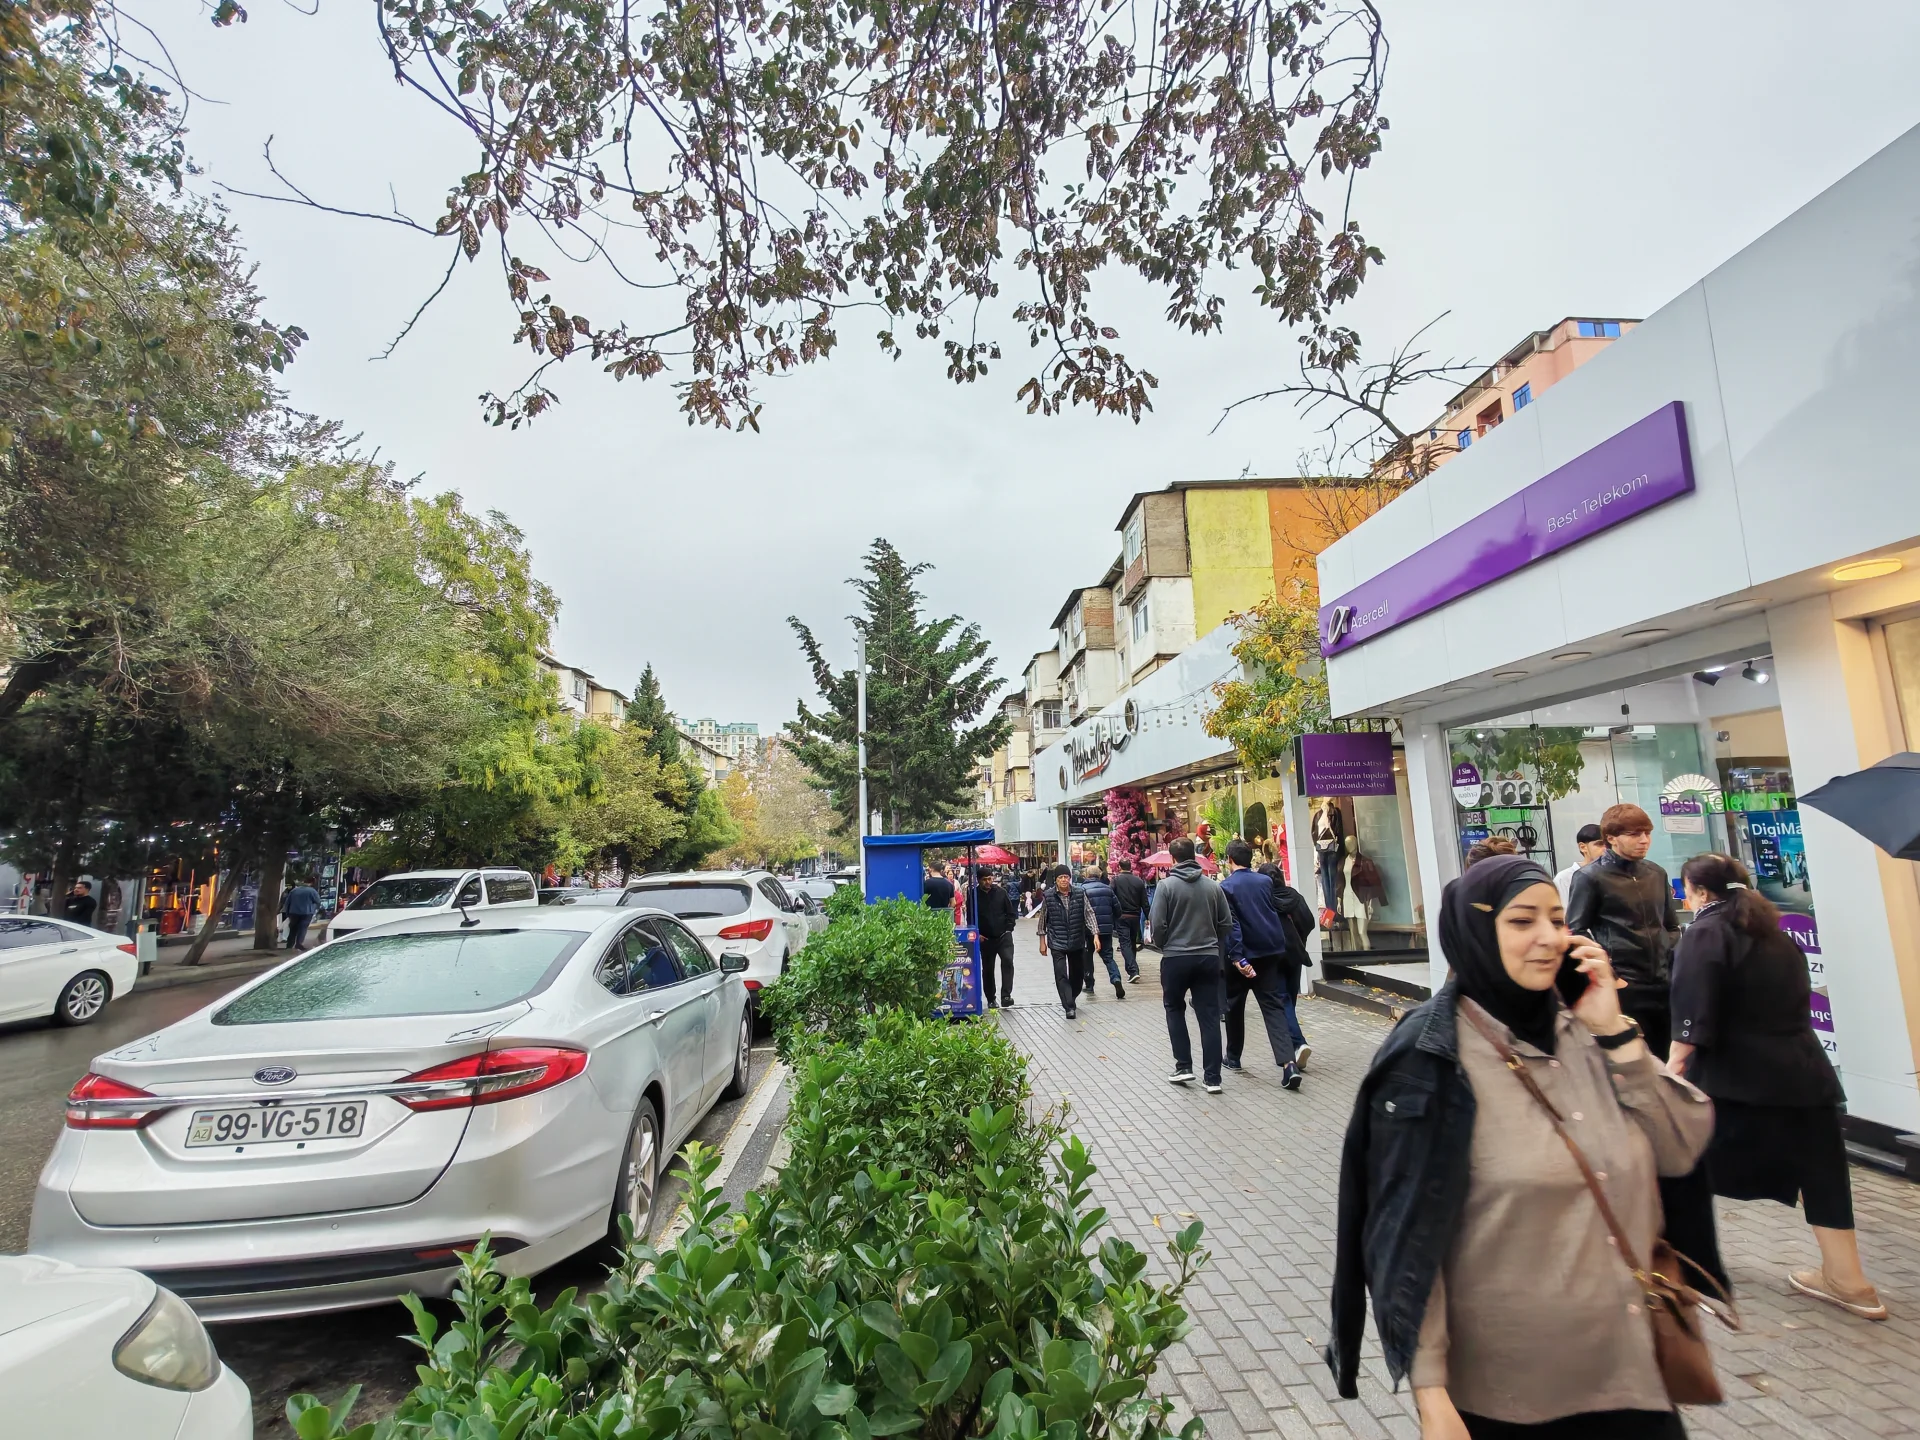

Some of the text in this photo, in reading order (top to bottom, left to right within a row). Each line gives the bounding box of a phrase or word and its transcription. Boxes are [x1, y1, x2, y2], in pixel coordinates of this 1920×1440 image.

[1547, 473, 1649, 533] Best Telekom
[1351, 599, 1389, 632] Azercell
[1362, 772, 1389, 781] topdan
[1659, 795, 1699, 815] Best
[1077, 817, 1101, 825] PARK
[260, 1069, 285, 1081] Ford
[193, 1106, 358, 1142] AZ 99-VG-518
